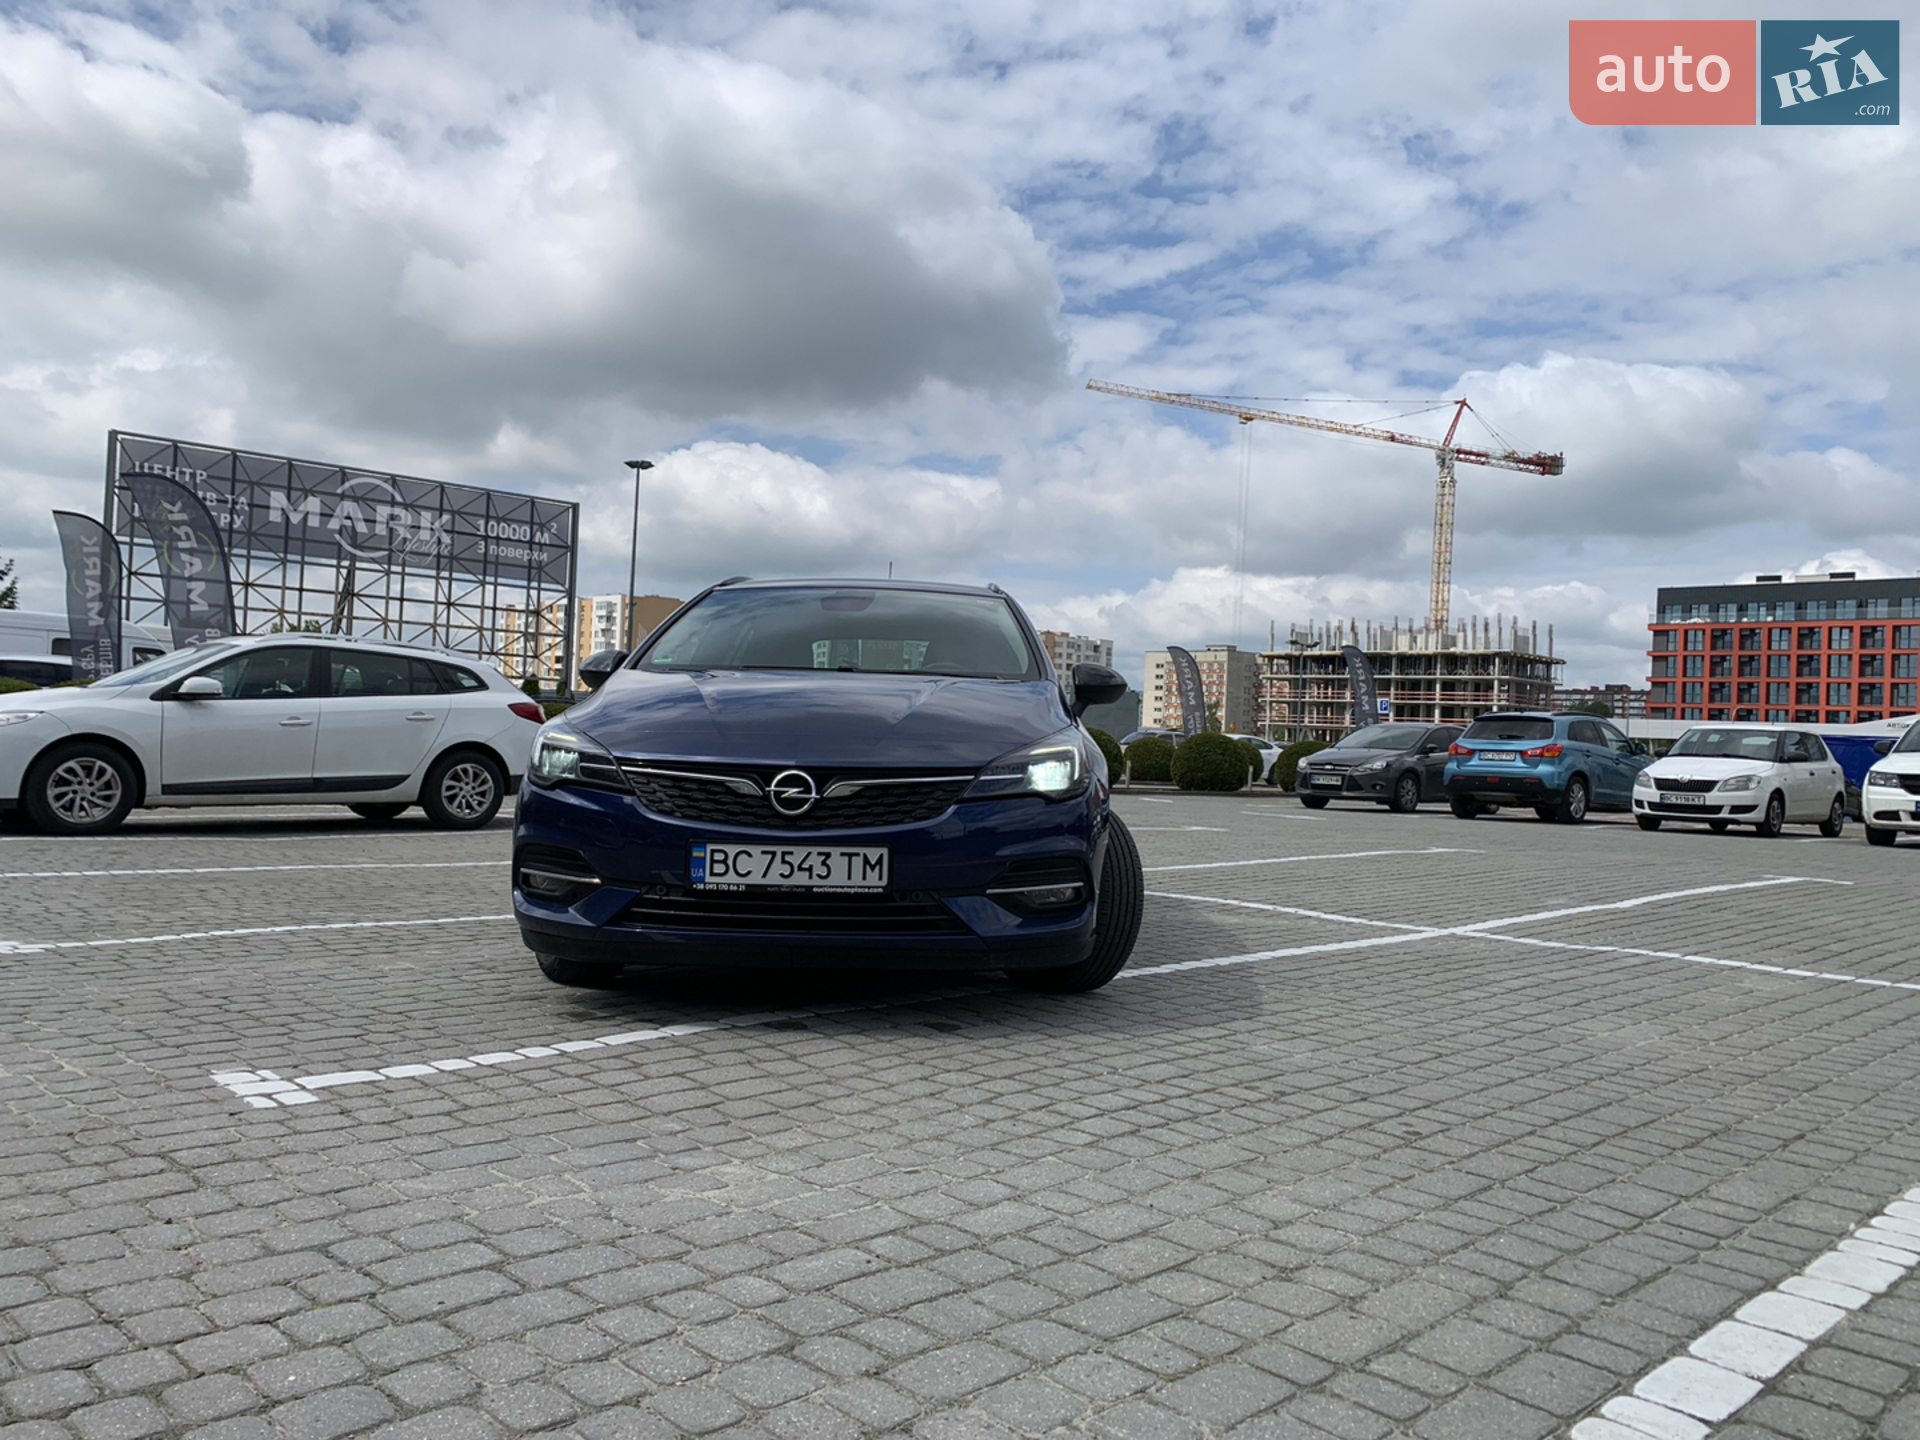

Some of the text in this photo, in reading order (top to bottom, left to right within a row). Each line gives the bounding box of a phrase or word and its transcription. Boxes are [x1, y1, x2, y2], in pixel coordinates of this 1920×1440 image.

[225, 493, 250, 512] ТА
[269, 490, 452, 544] MARK
[476, 519, 531, 541] 10000
[476, 540, 548, 562] 3 поверхи
[691, 867, 704, 878] UA
[708, 848, 884, 882] BC 7543 TM
